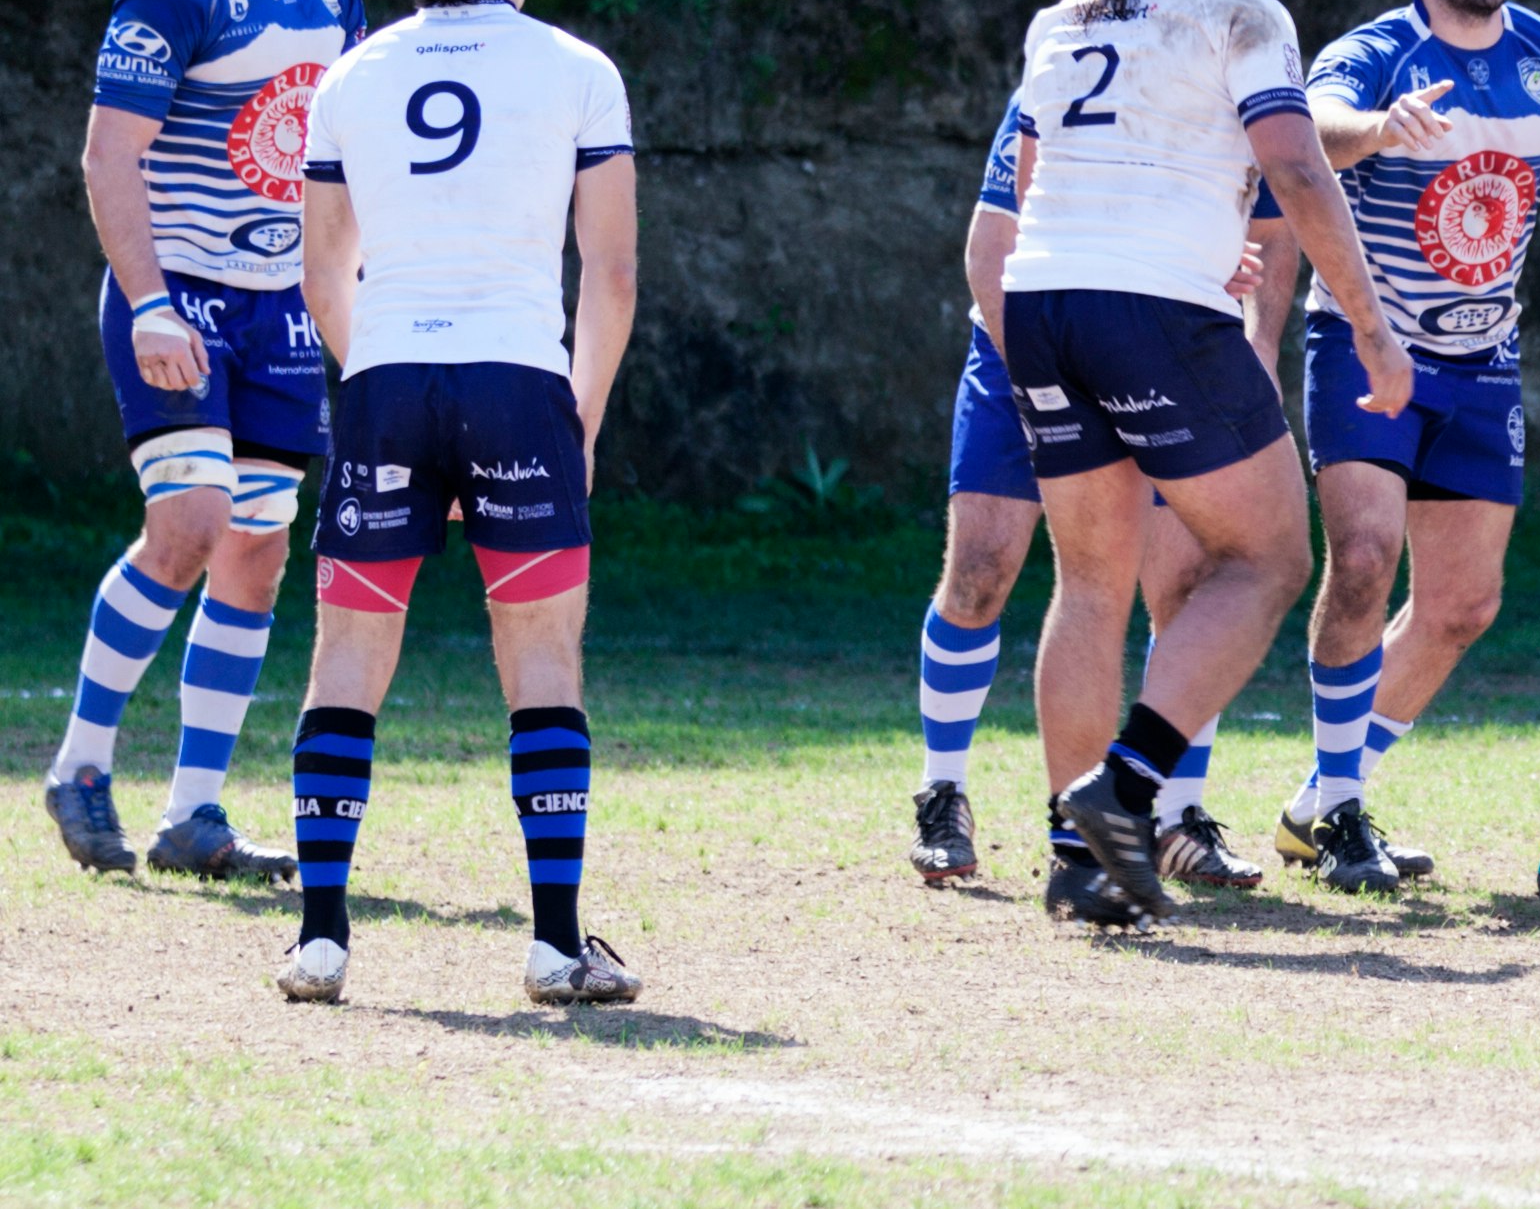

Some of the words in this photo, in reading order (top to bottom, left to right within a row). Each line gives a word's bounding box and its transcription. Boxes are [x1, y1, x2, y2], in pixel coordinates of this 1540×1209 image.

[1062, 44, 1120, 127] 2
[406, 81, 482, 175] 9
[231, 130, 303, 202] TROCA
[1433, 153, 1534, 195] GRUPO
[470, 457, 551, 482] Andalucía
